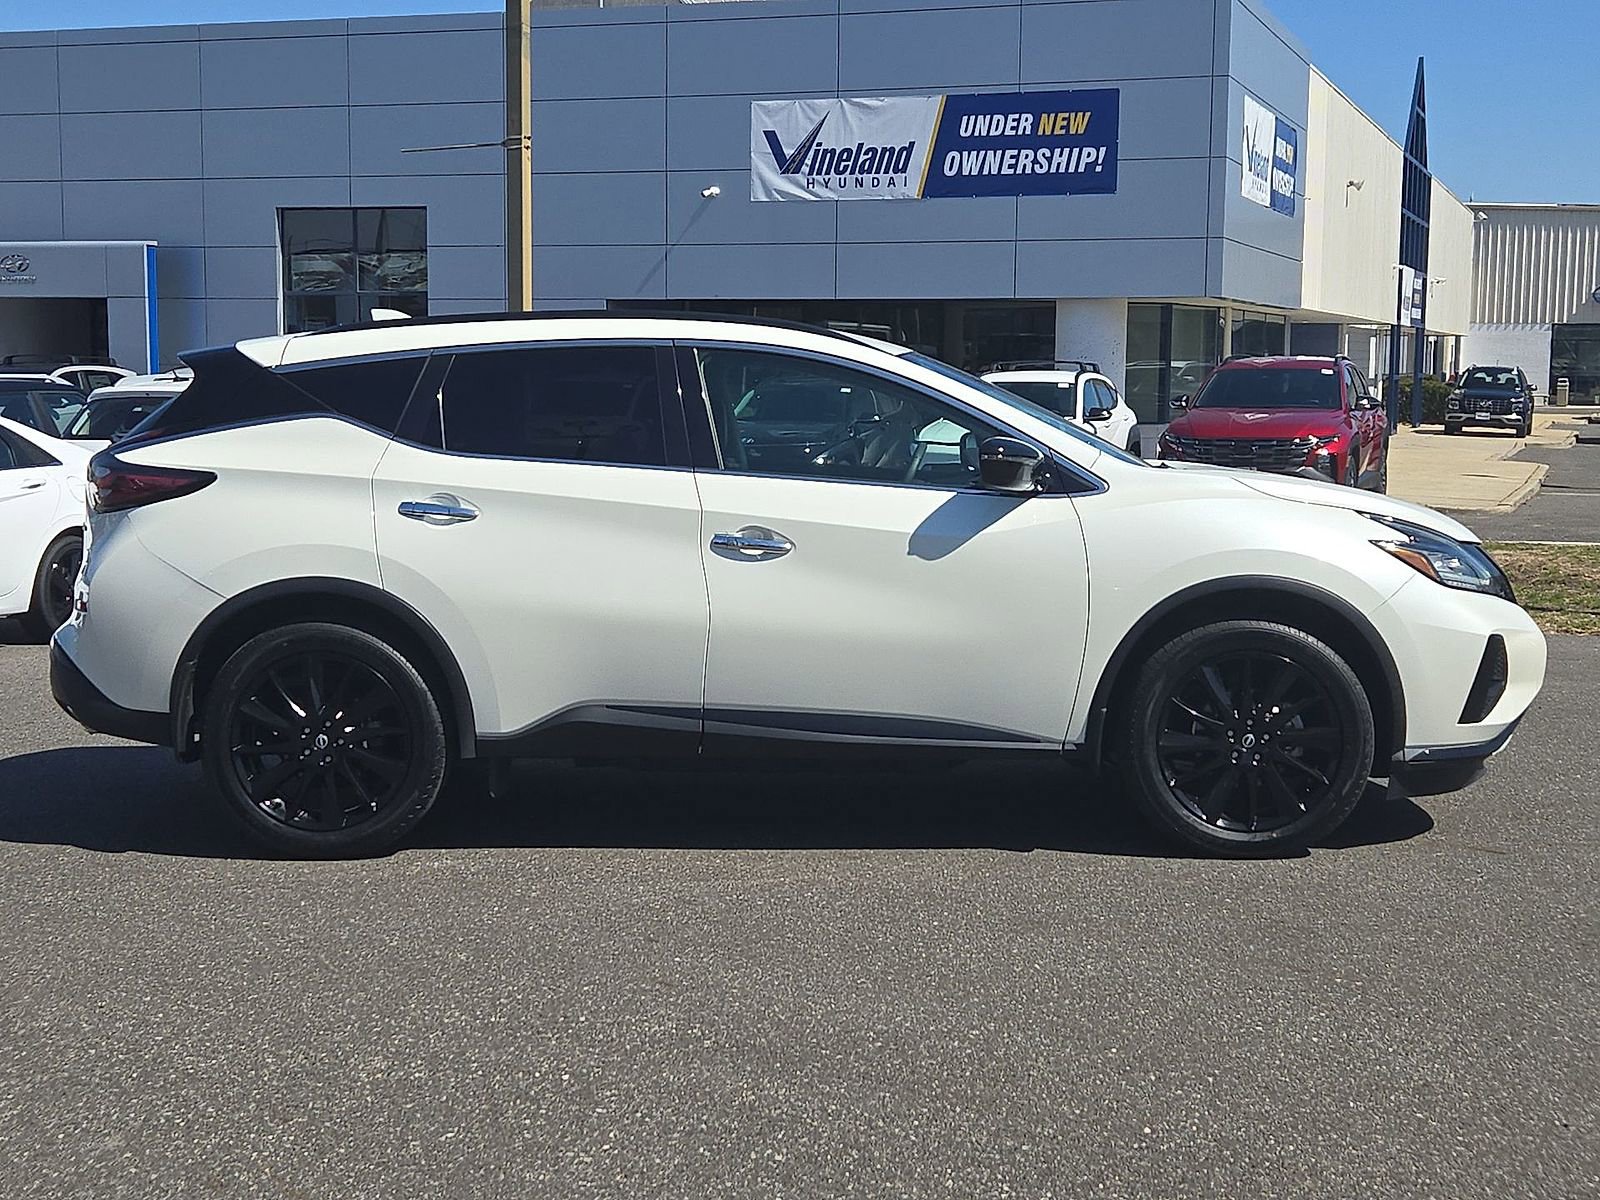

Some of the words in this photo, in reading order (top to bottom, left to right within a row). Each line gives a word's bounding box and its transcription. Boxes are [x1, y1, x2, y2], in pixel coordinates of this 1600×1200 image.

[959, 113, 1034, 137] UNDER
[1037, 111, 1091, 136] NEW
[763, 110, 915, 176] Vineland
[943, 146, 1106, 177] OWNERSHIP!
[806, 175, 908, 189] HYUNDAI
